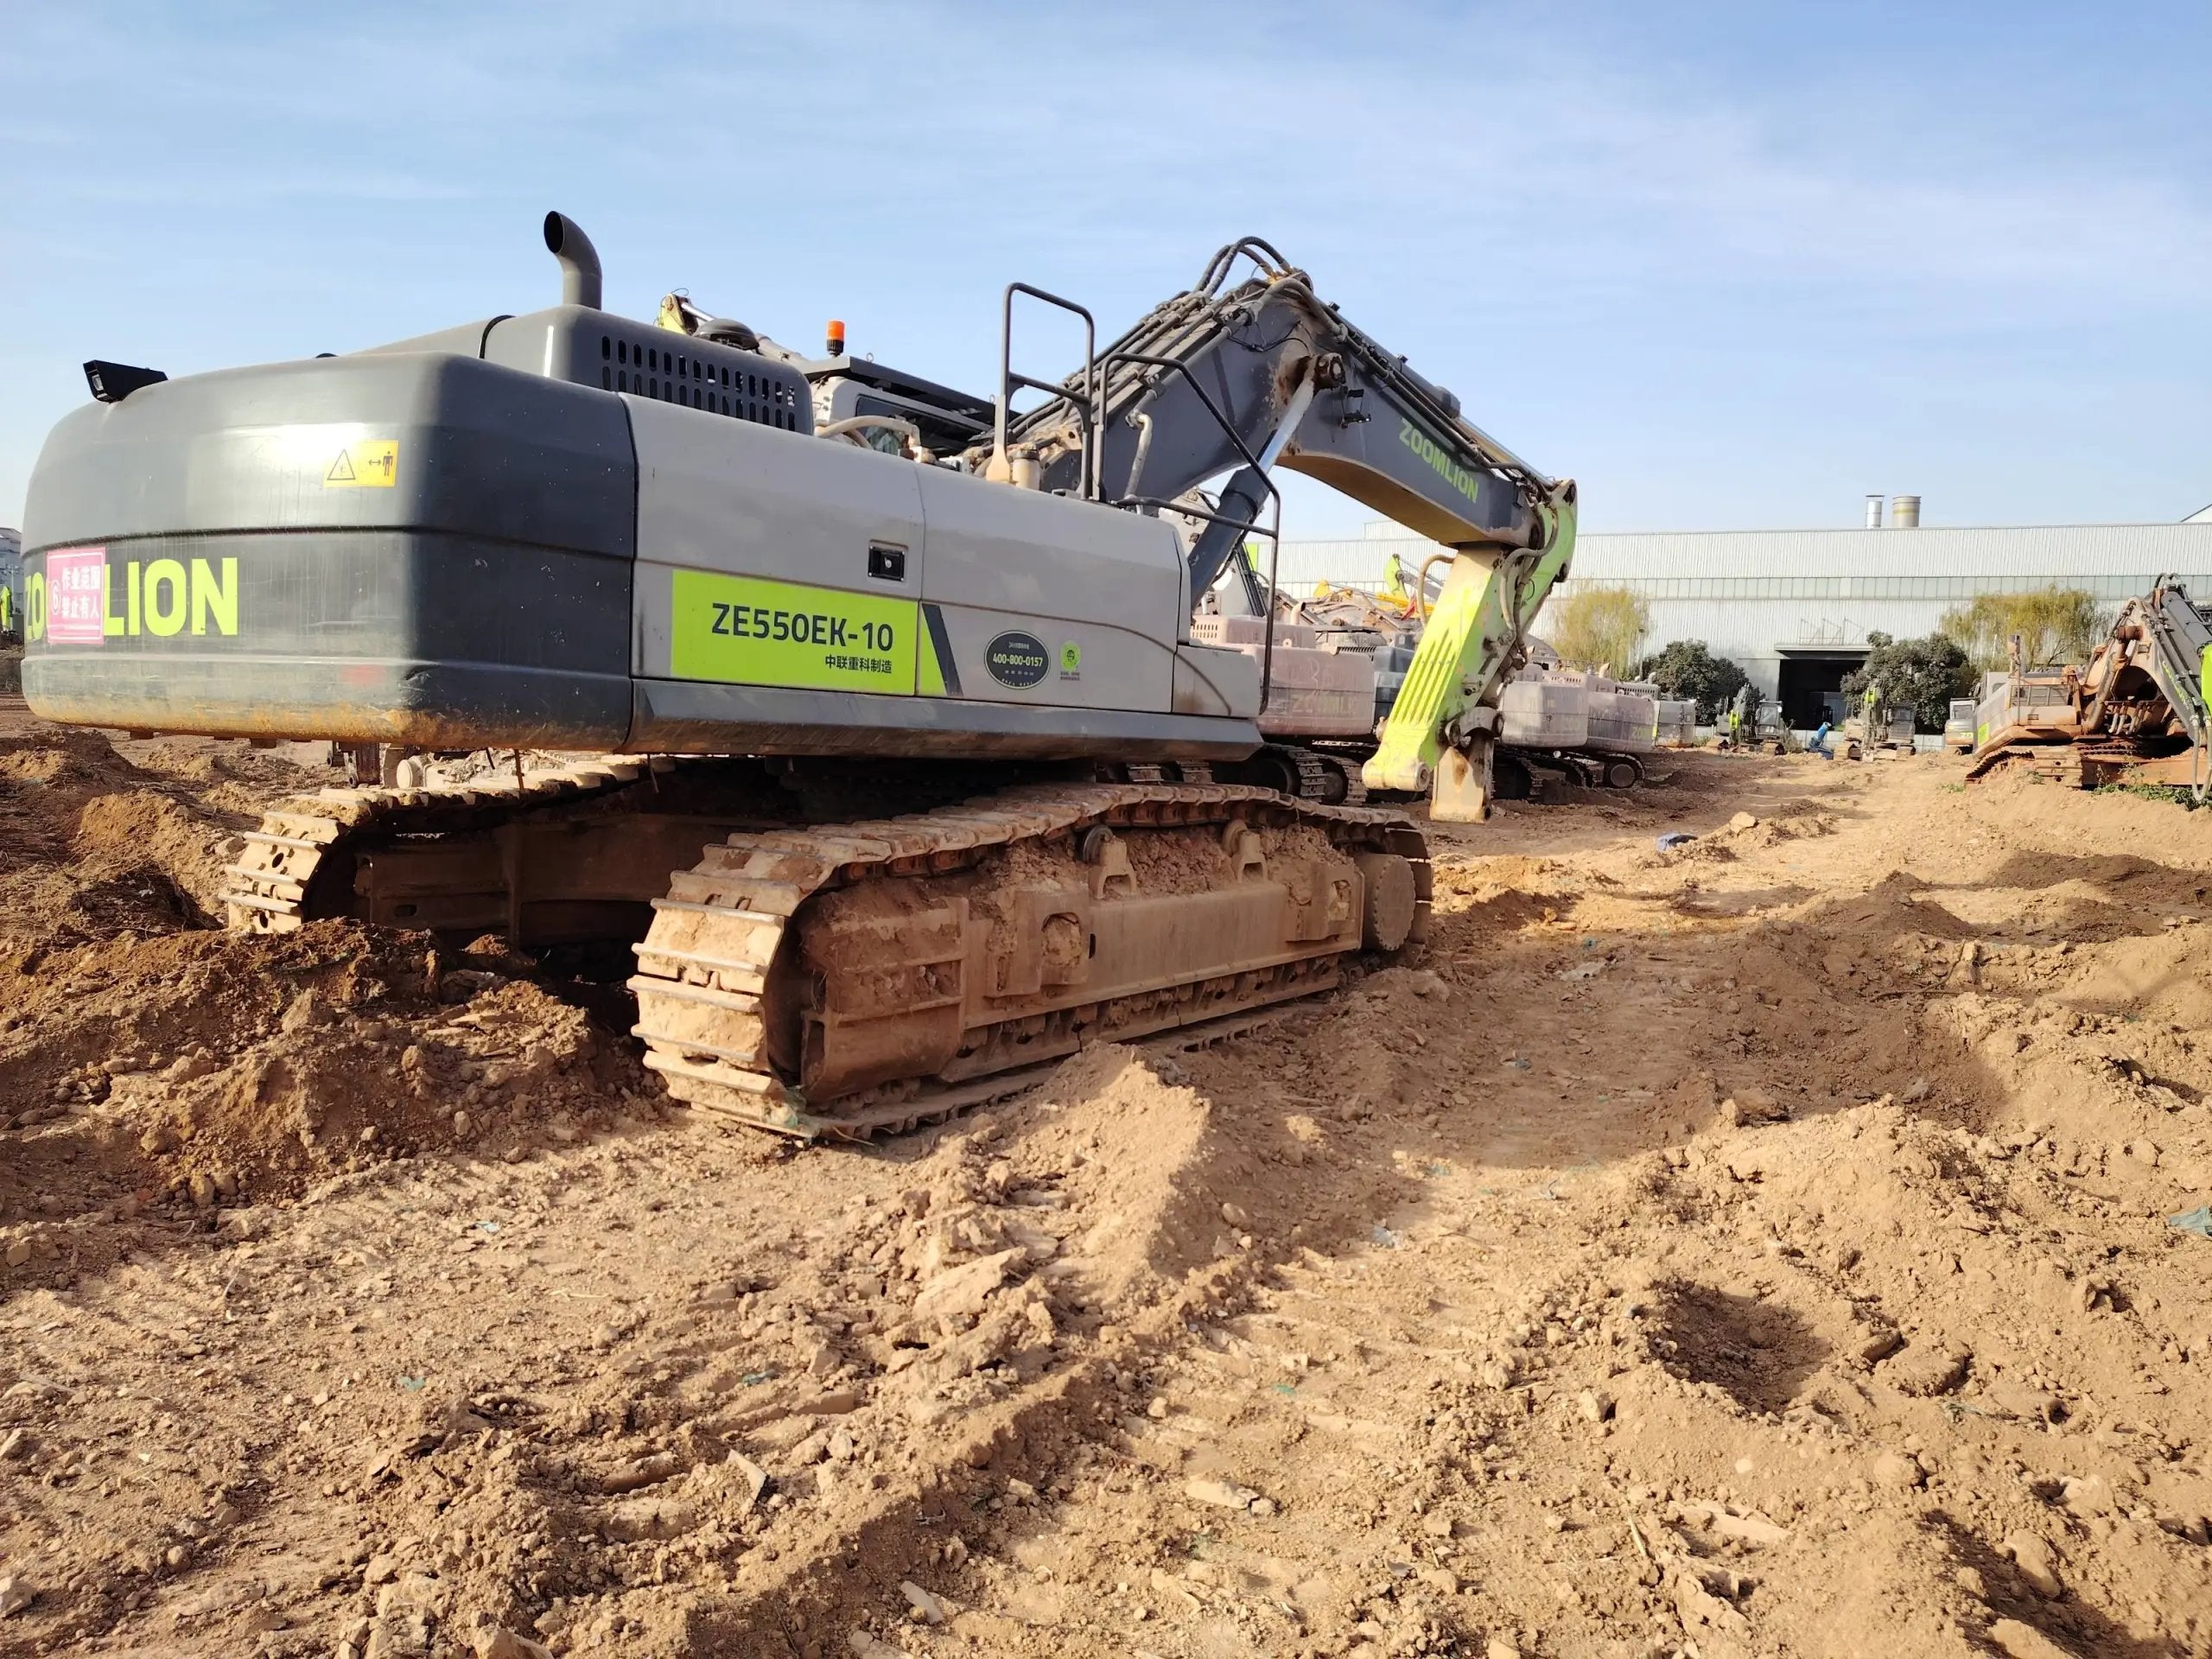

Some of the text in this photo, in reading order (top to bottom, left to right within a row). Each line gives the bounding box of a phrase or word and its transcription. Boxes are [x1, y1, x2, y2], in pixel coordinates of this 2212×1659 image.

[1399, 416, 1479, 504] ZOOMLION
[25, 557, 238, 640] ZOLION
[62, 594, 100, 620] 禁止有人
[711, 602, 893, 652] ZE550EK-10
[825, 654, 893, 674] 中联重科制造
[993, 652, 1044, 667] 400-800-0157
